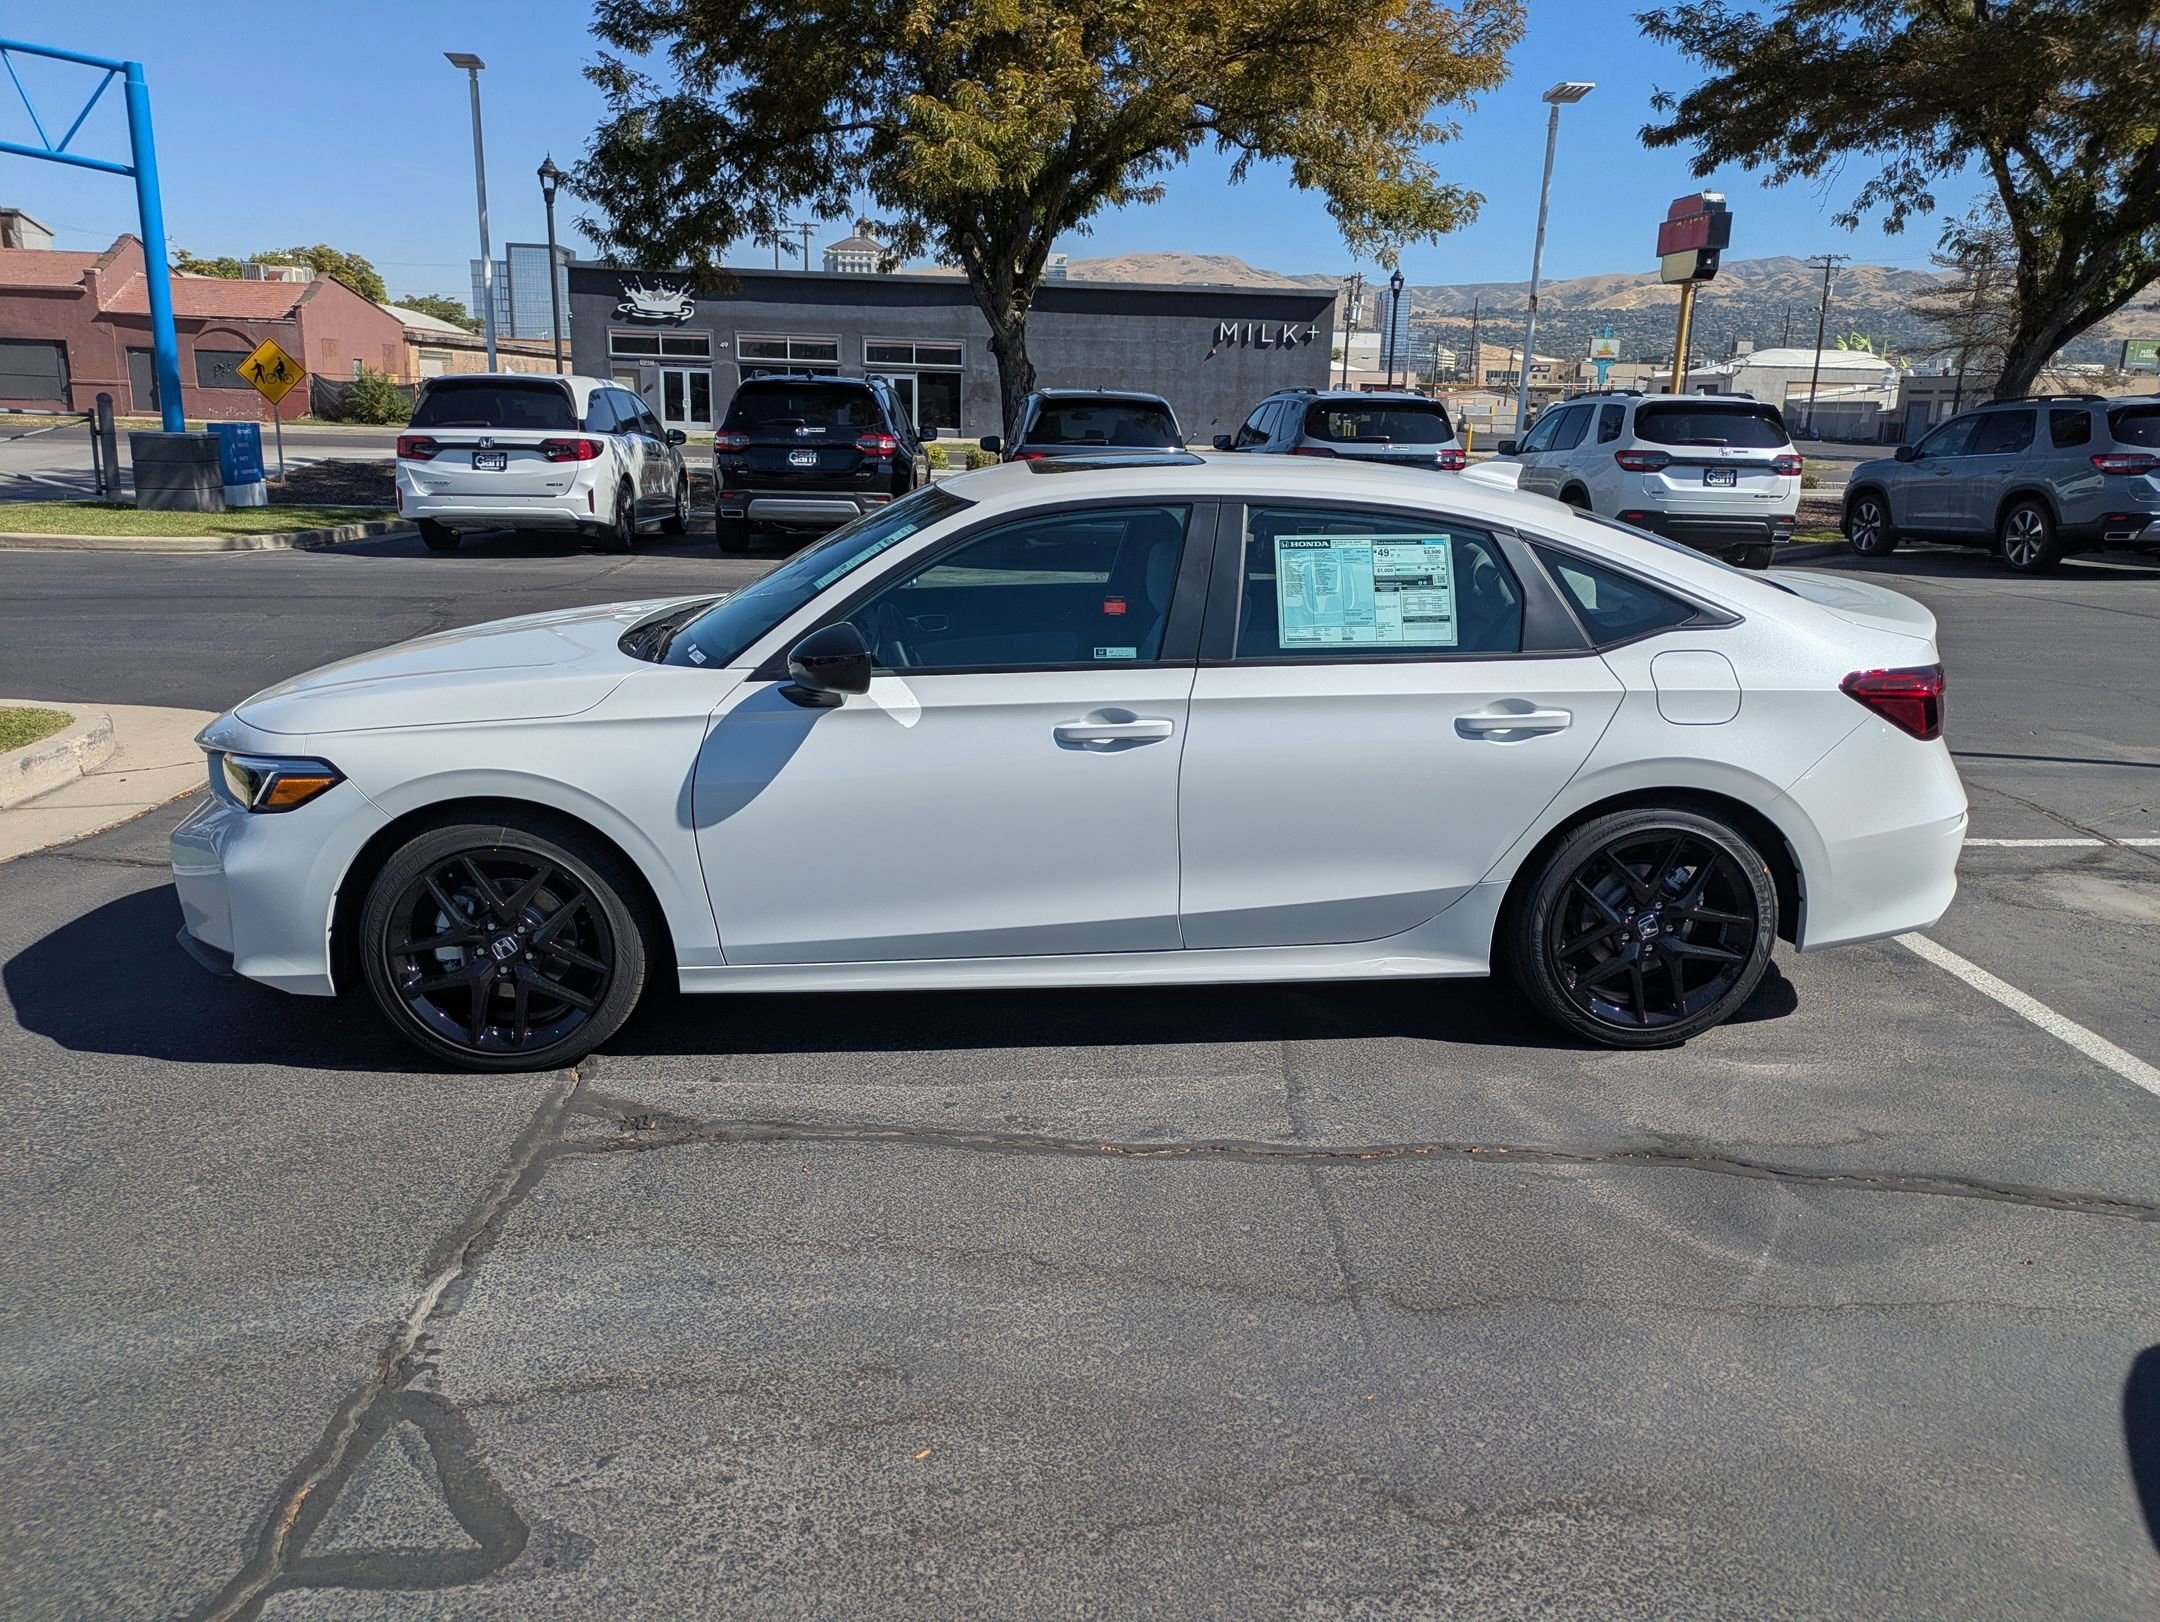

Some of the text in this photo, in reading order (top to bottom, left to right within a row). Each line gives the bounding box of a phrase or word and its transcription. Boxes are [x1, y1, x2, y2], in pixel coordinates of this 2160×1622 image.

[1220, 321, 1320, 343] MILK+
[475, 455, 505, 467] Garff
[789, 452, 817, 463] Garff
[1706, 472, 1735, 484] Garff
[1377, 549, 1390, 557] 49
